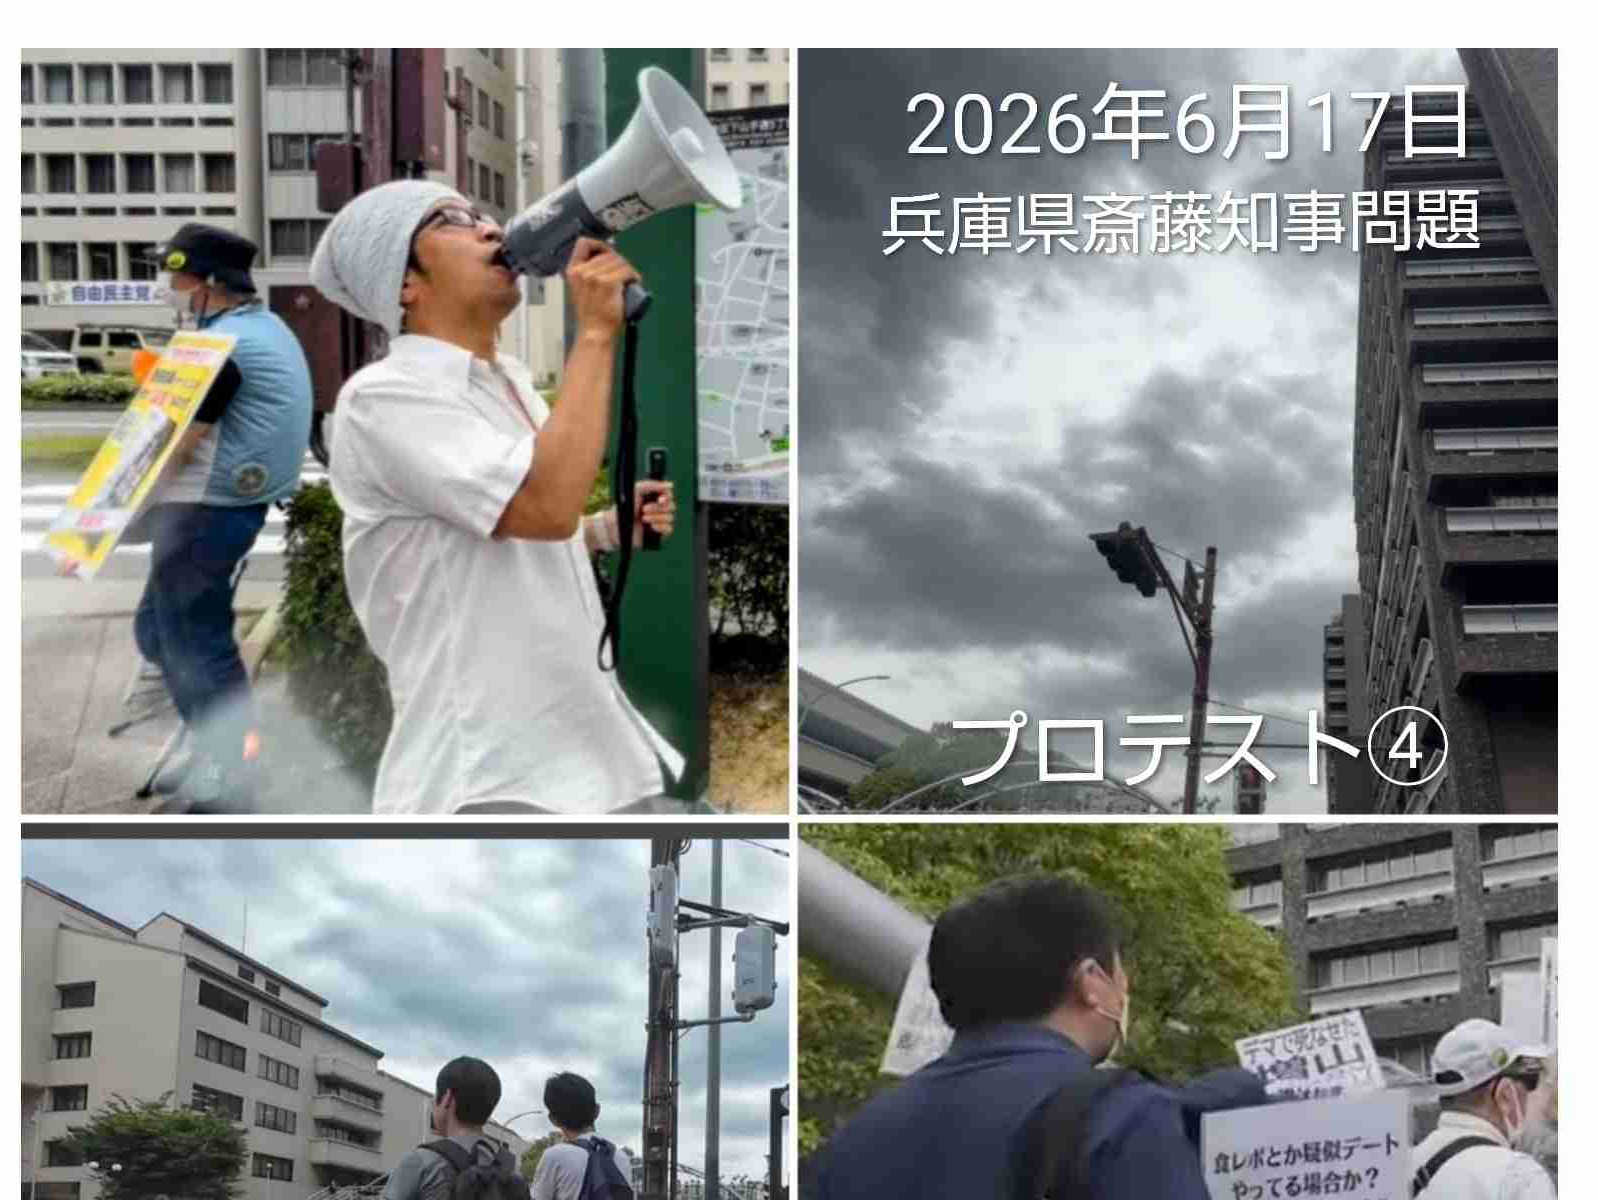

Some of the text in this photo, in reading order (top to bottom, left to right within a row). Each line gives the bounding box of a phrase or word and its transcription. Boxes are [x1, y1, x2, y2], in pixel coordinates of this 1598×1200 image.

[72, 284, 150, 302] 自由民主党
[1214, 1131, 1400, 1175] 食レポとか疑似デート
